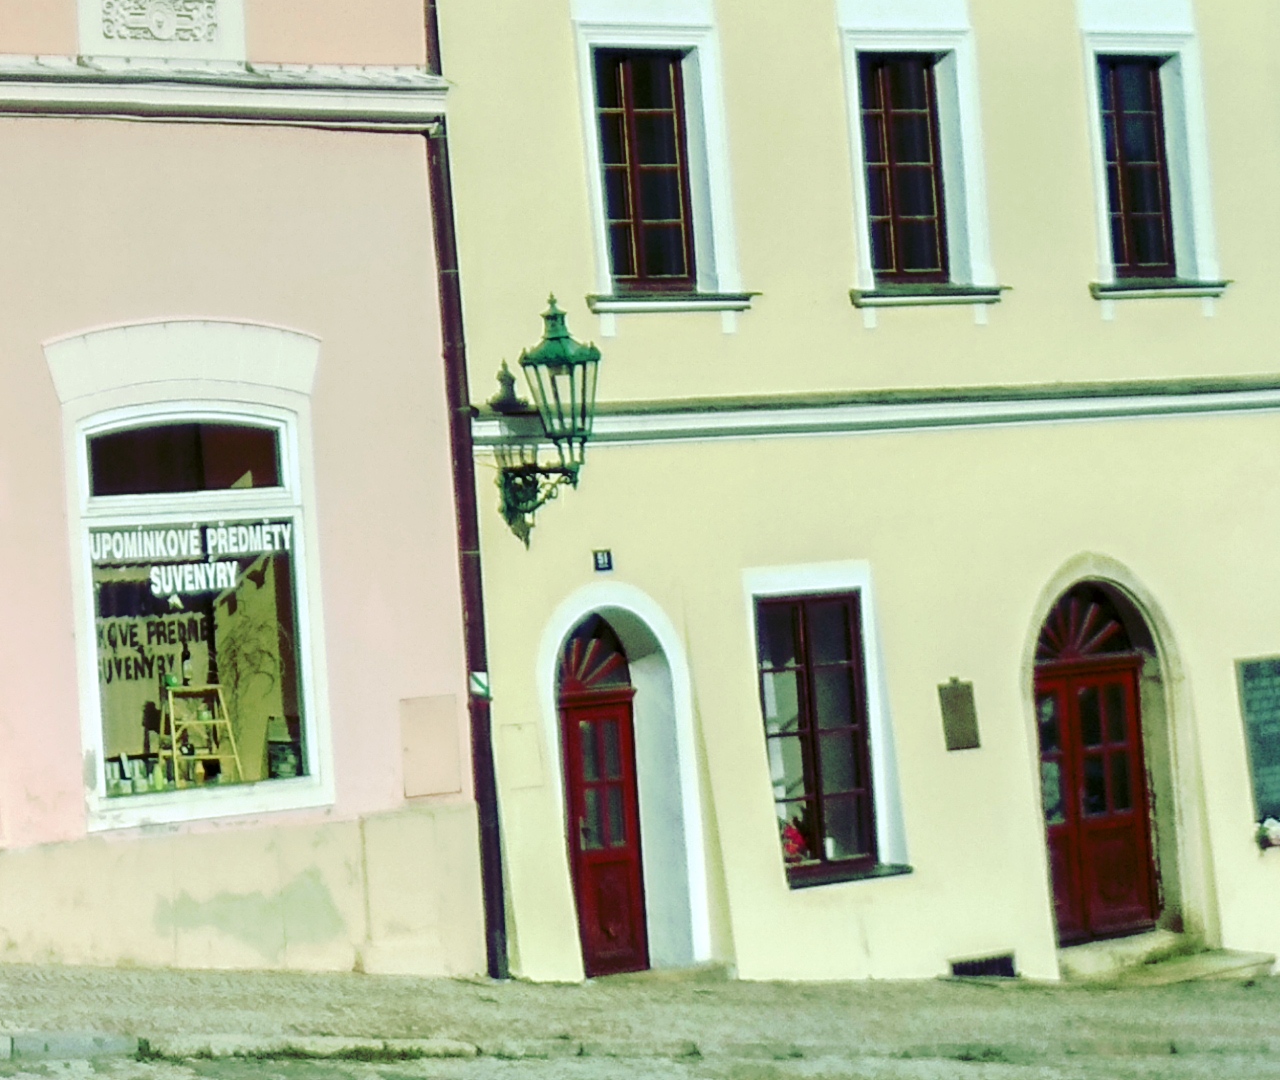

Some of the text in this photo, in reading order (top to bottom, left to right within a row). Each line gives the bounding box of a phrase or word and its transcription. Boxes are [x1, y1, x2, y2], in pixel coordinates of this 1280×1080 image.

[90, 518, 292, 560] UPOMÍNKOVÉ PŘEDMĚTY
[149, 555, 239, 595] SUVENÝRY
